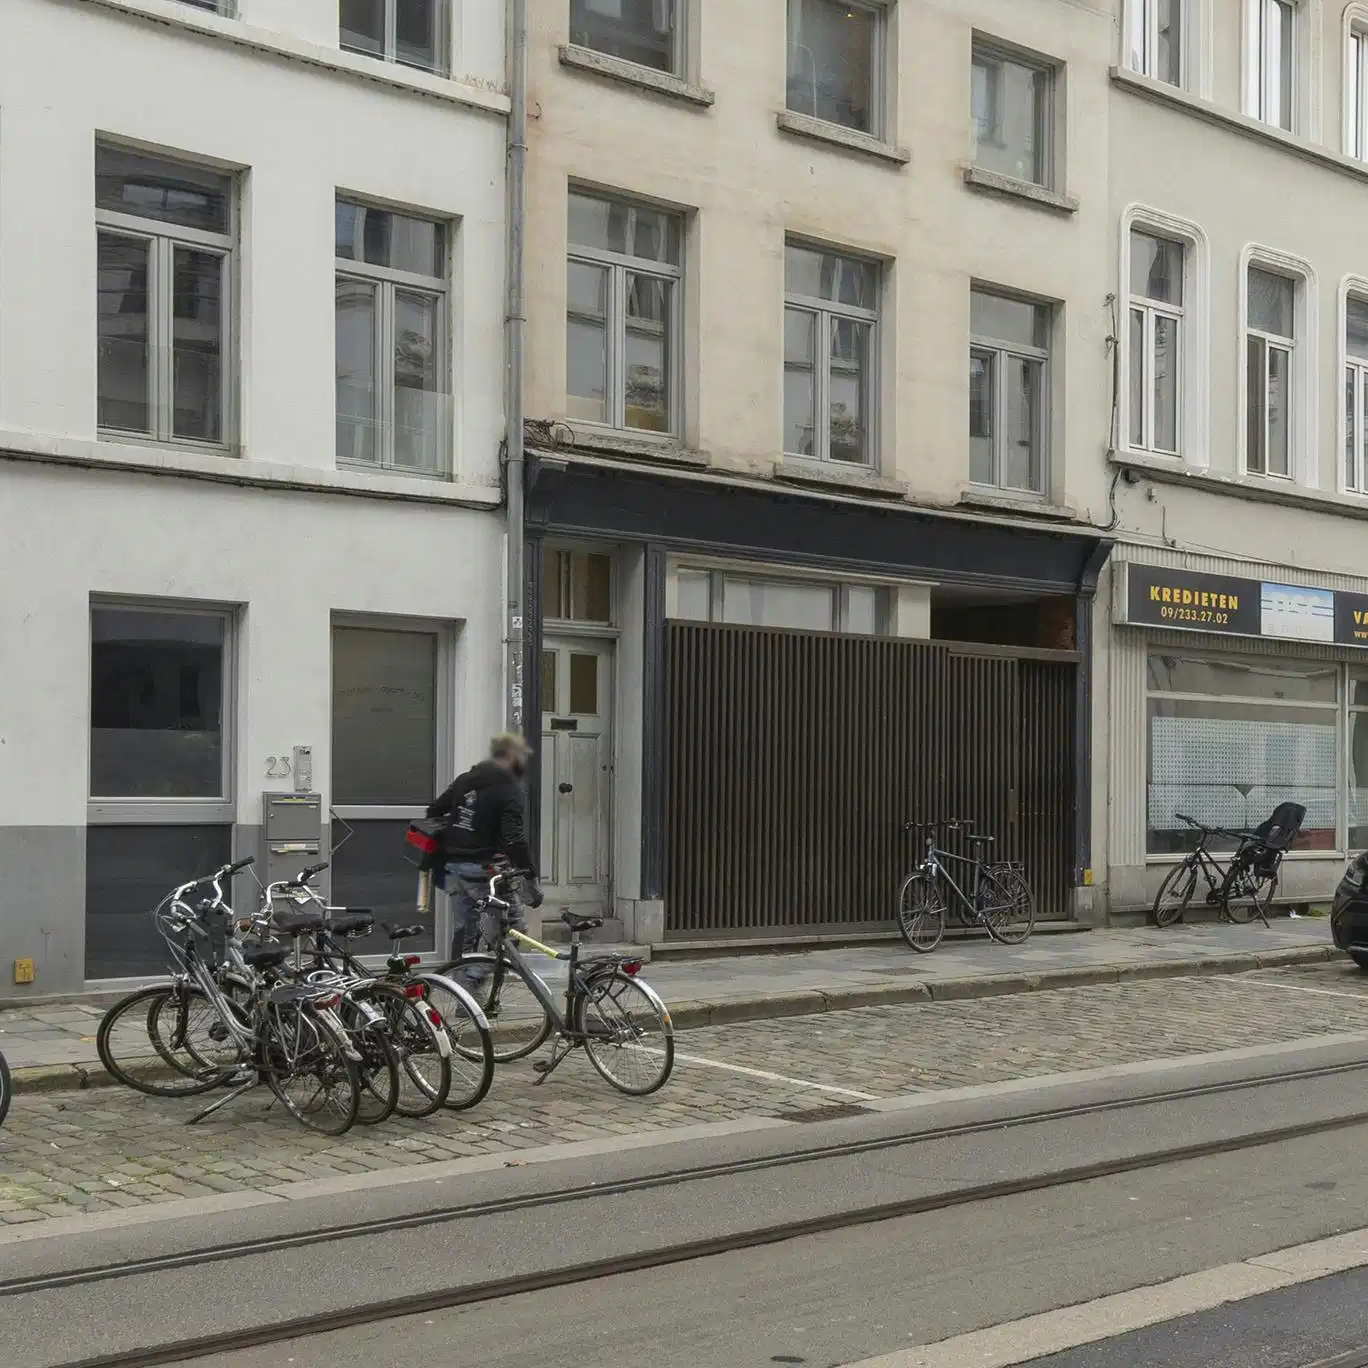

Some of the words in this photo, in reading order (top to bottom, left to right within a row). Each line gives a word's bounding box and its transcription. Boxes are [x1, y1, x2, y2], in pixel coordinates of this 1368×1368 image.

[1149, 585, 1239, 610] KREDIETEN
[1160, 606, 1228, 624] 09/233.27.02
[264, 756, 292, 777] 23
